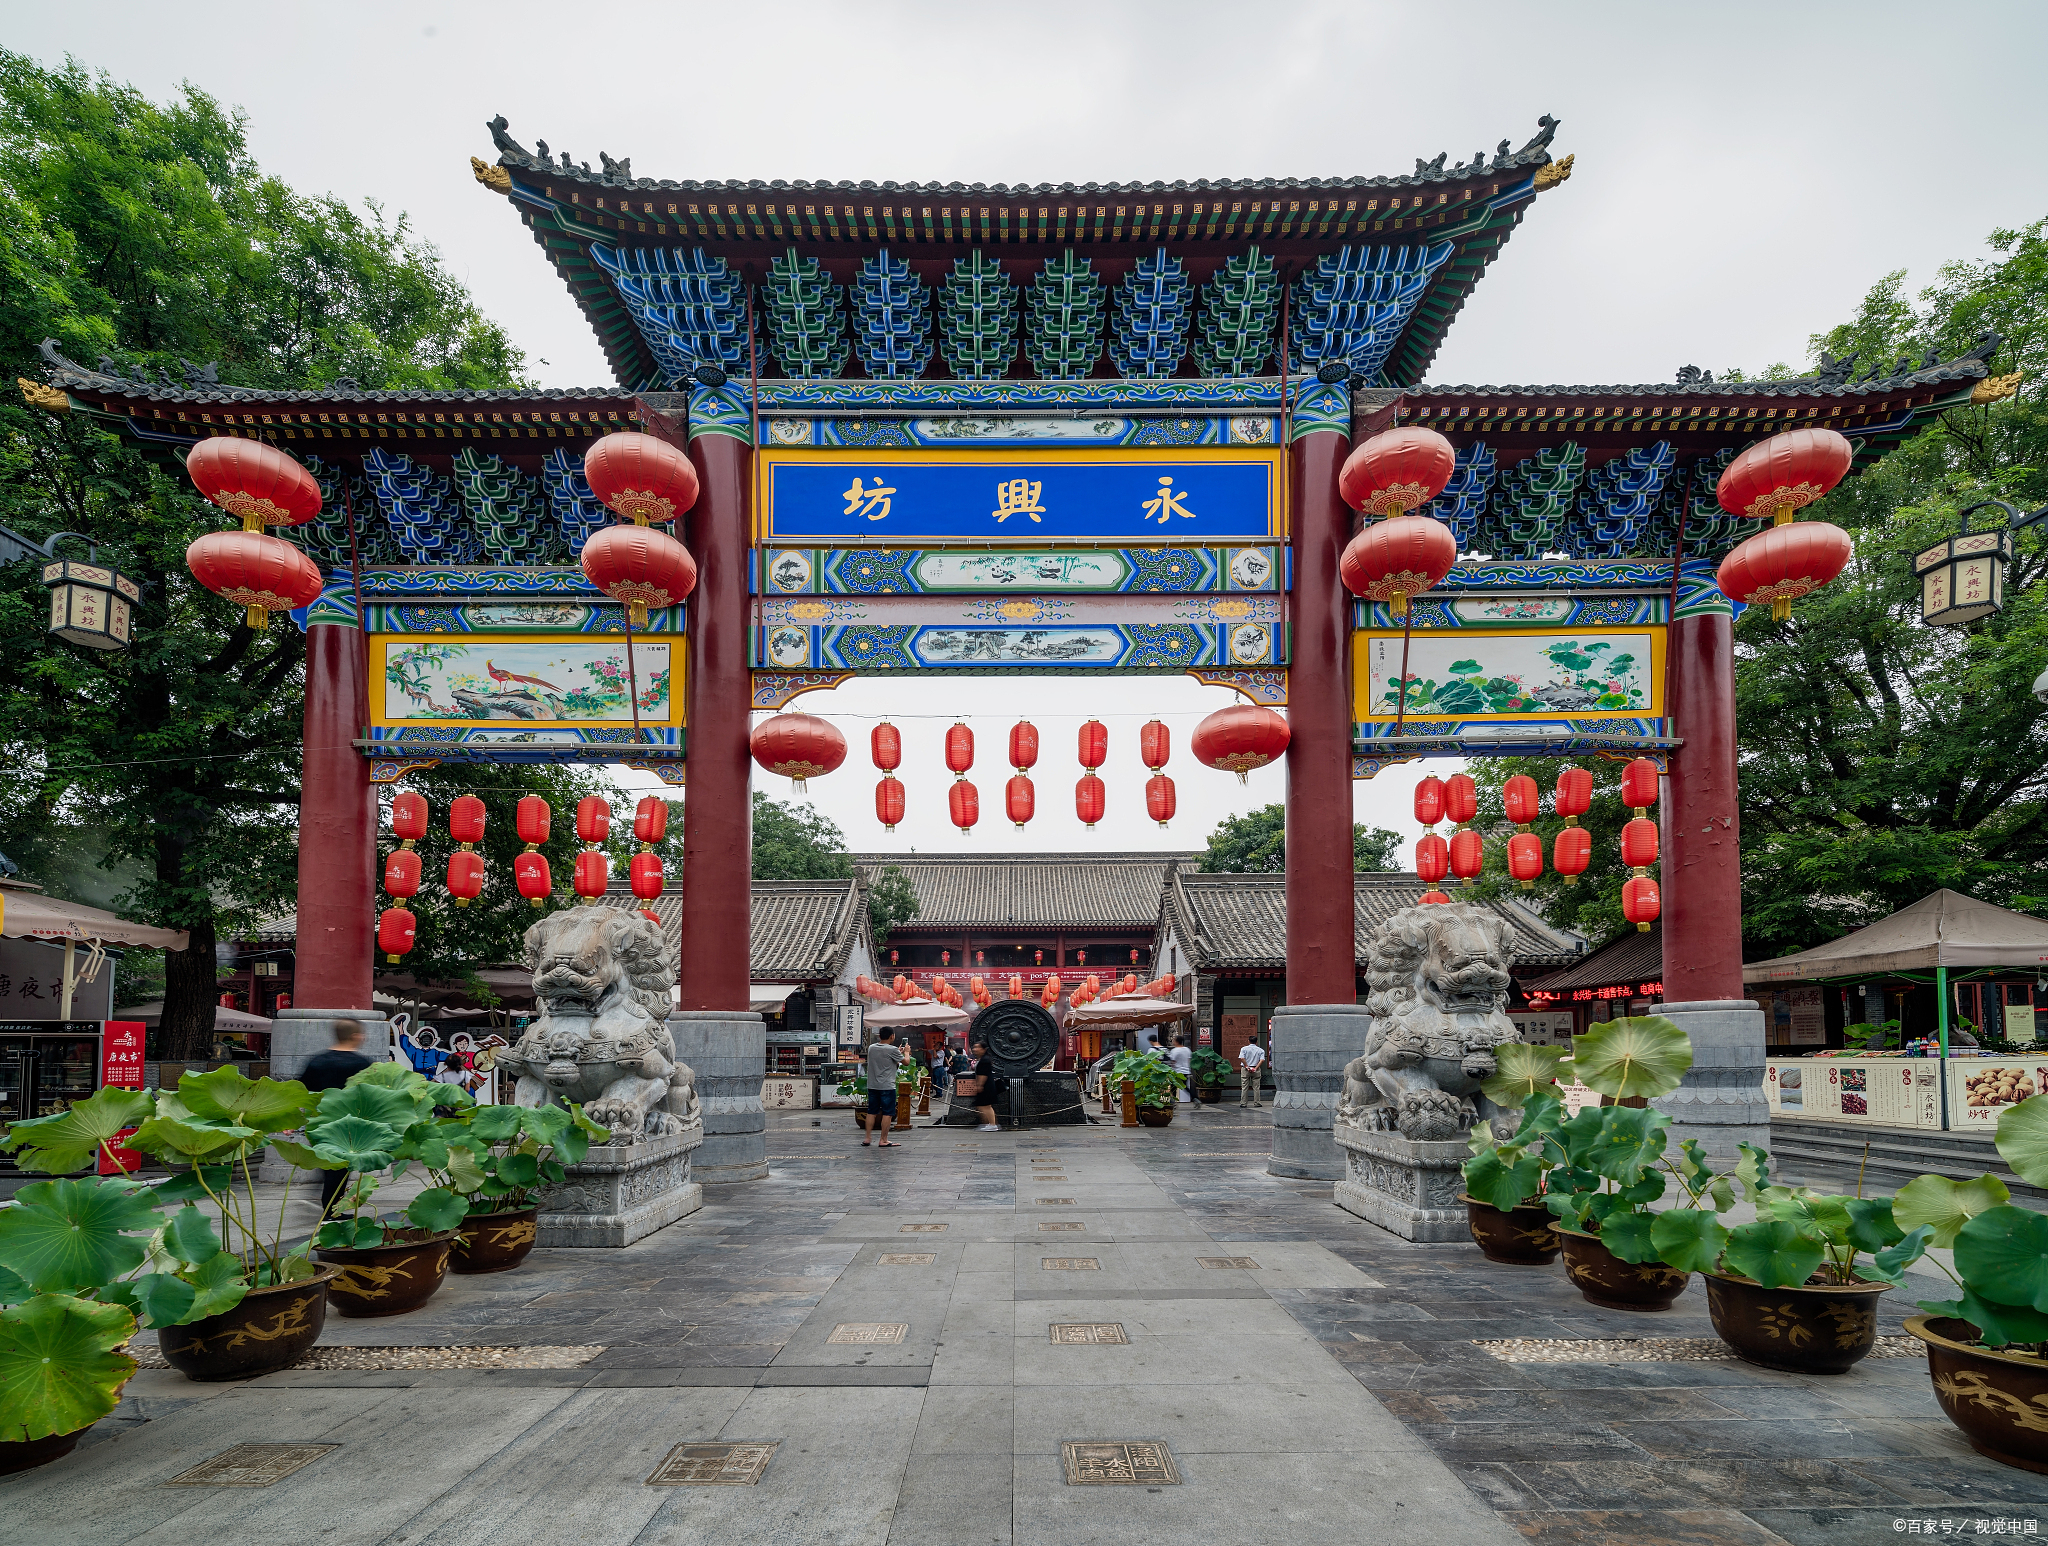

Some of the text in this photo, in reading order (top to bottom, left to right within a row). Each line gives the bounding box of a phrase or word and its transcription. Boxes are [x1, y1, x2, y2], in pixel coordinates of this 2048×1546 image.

[843, 476, 1197, 524] 永興坊
[1964, 565, 1982, 600] 永興坊
[79, 592, 98, 626] 永興坊
